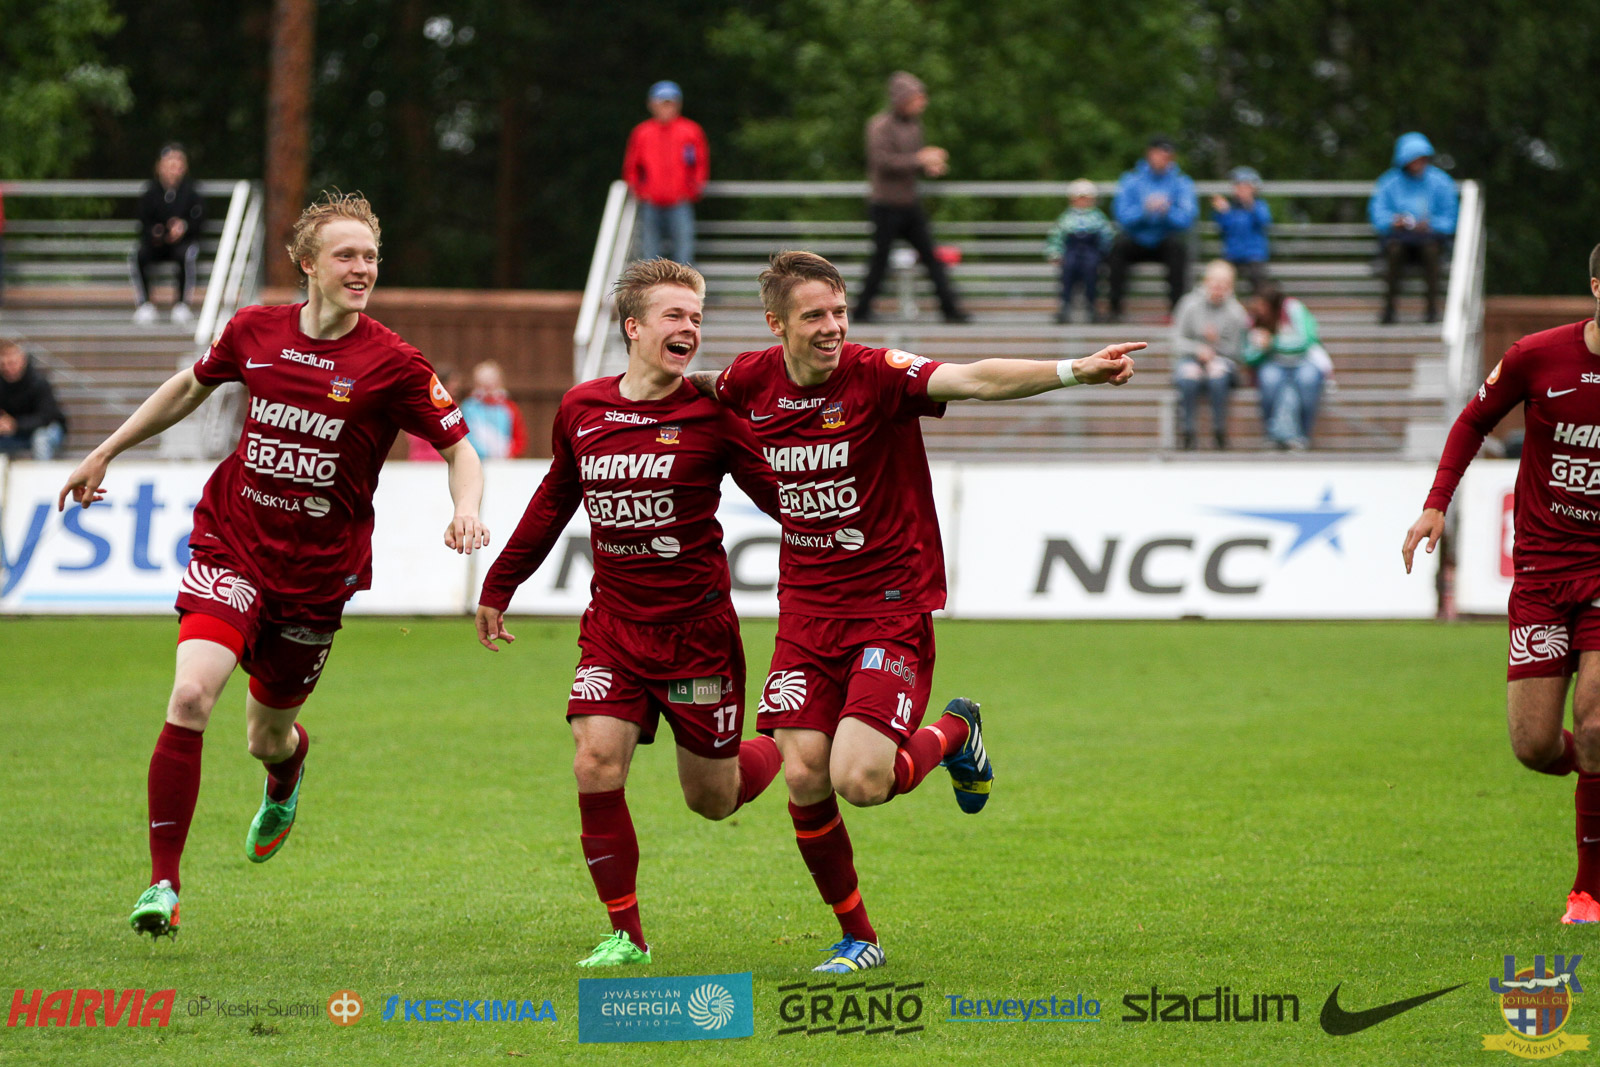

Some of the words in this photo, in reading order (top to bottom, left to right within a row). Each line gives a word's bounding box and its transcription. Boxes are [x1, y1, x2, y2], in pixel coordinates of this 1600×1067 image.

[280, 348, 335, 370] stadium
[777, 397, 826, 410] stadium
[250, 396, 345, 442] HARVIA
[604, 410, 658, 425] stadium
[247, 440, 336, 481] GRANO
[580, 453, 676, 480] HARVIA
[763, 441, 850, 472] HARVIA
[241, 486, 301, 512] JYVÄSKYLÄ
[587, 497, 674, 521] GRANO
[778, 486, 858, 512] GRANO
[1034, 538, 1269, 594] NCC
[313, 648, 329, 671] 3
[677, 682, 688, 695] la
[697, 682, 718, 696] mit
[713, 704, 737, 733] 17
[896, 691, 913, 725] 16
